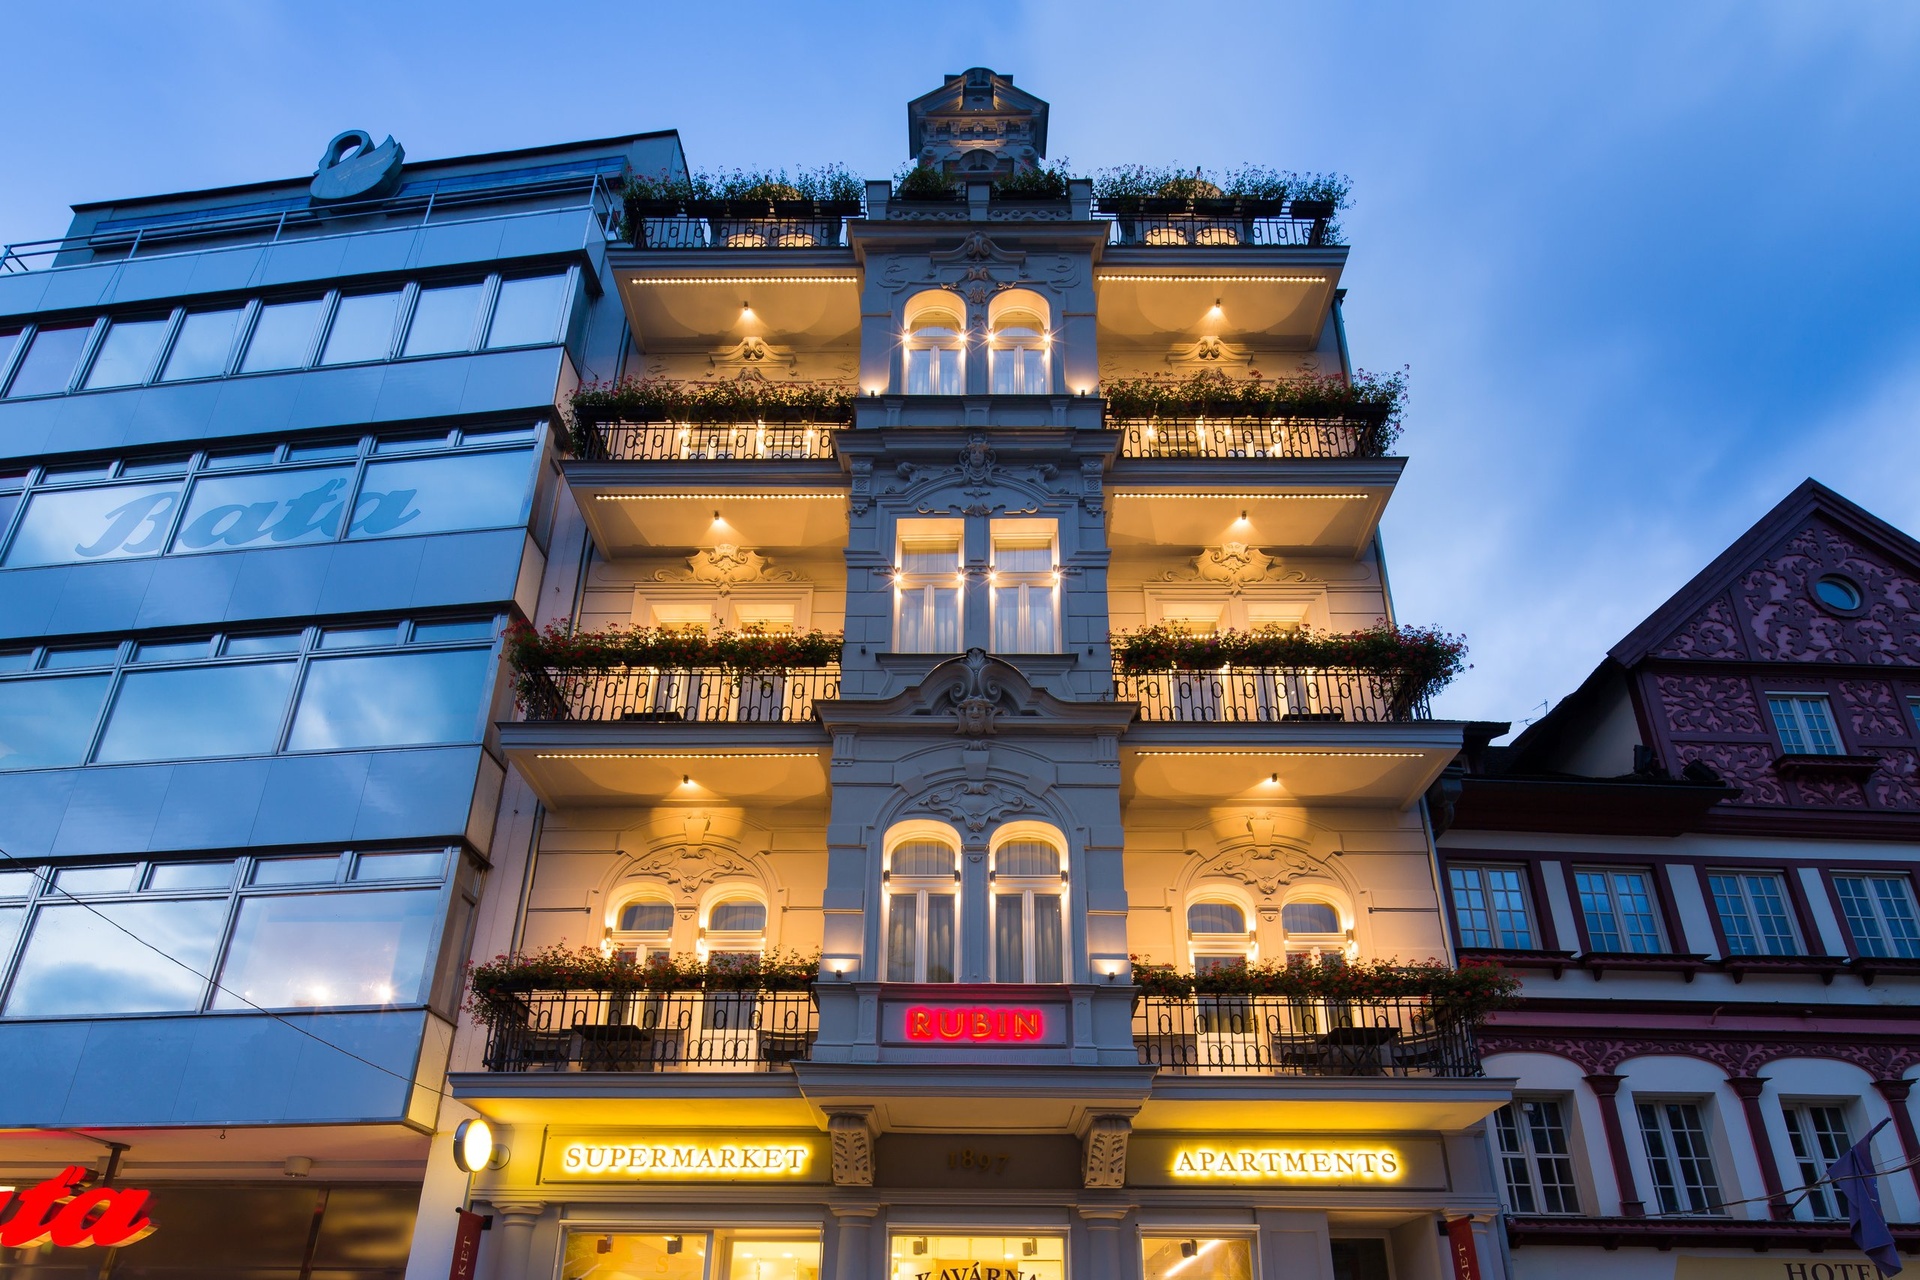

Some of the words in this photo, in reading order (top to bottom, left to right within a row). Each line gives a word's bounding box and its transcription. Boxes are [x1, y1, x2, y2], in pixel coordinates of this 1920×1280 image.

[75, 477, 420, 558] Baťa
[911, 1011, 1038, 1037] RUBIN
[566, 1147, 806, 1168] SUPERMARKET
[948, 1147, 1010, 1174] 1897
[1177, 1151, 1397, 1173] APARTMENTS
[0, 1165, 151, 1247] ťa
